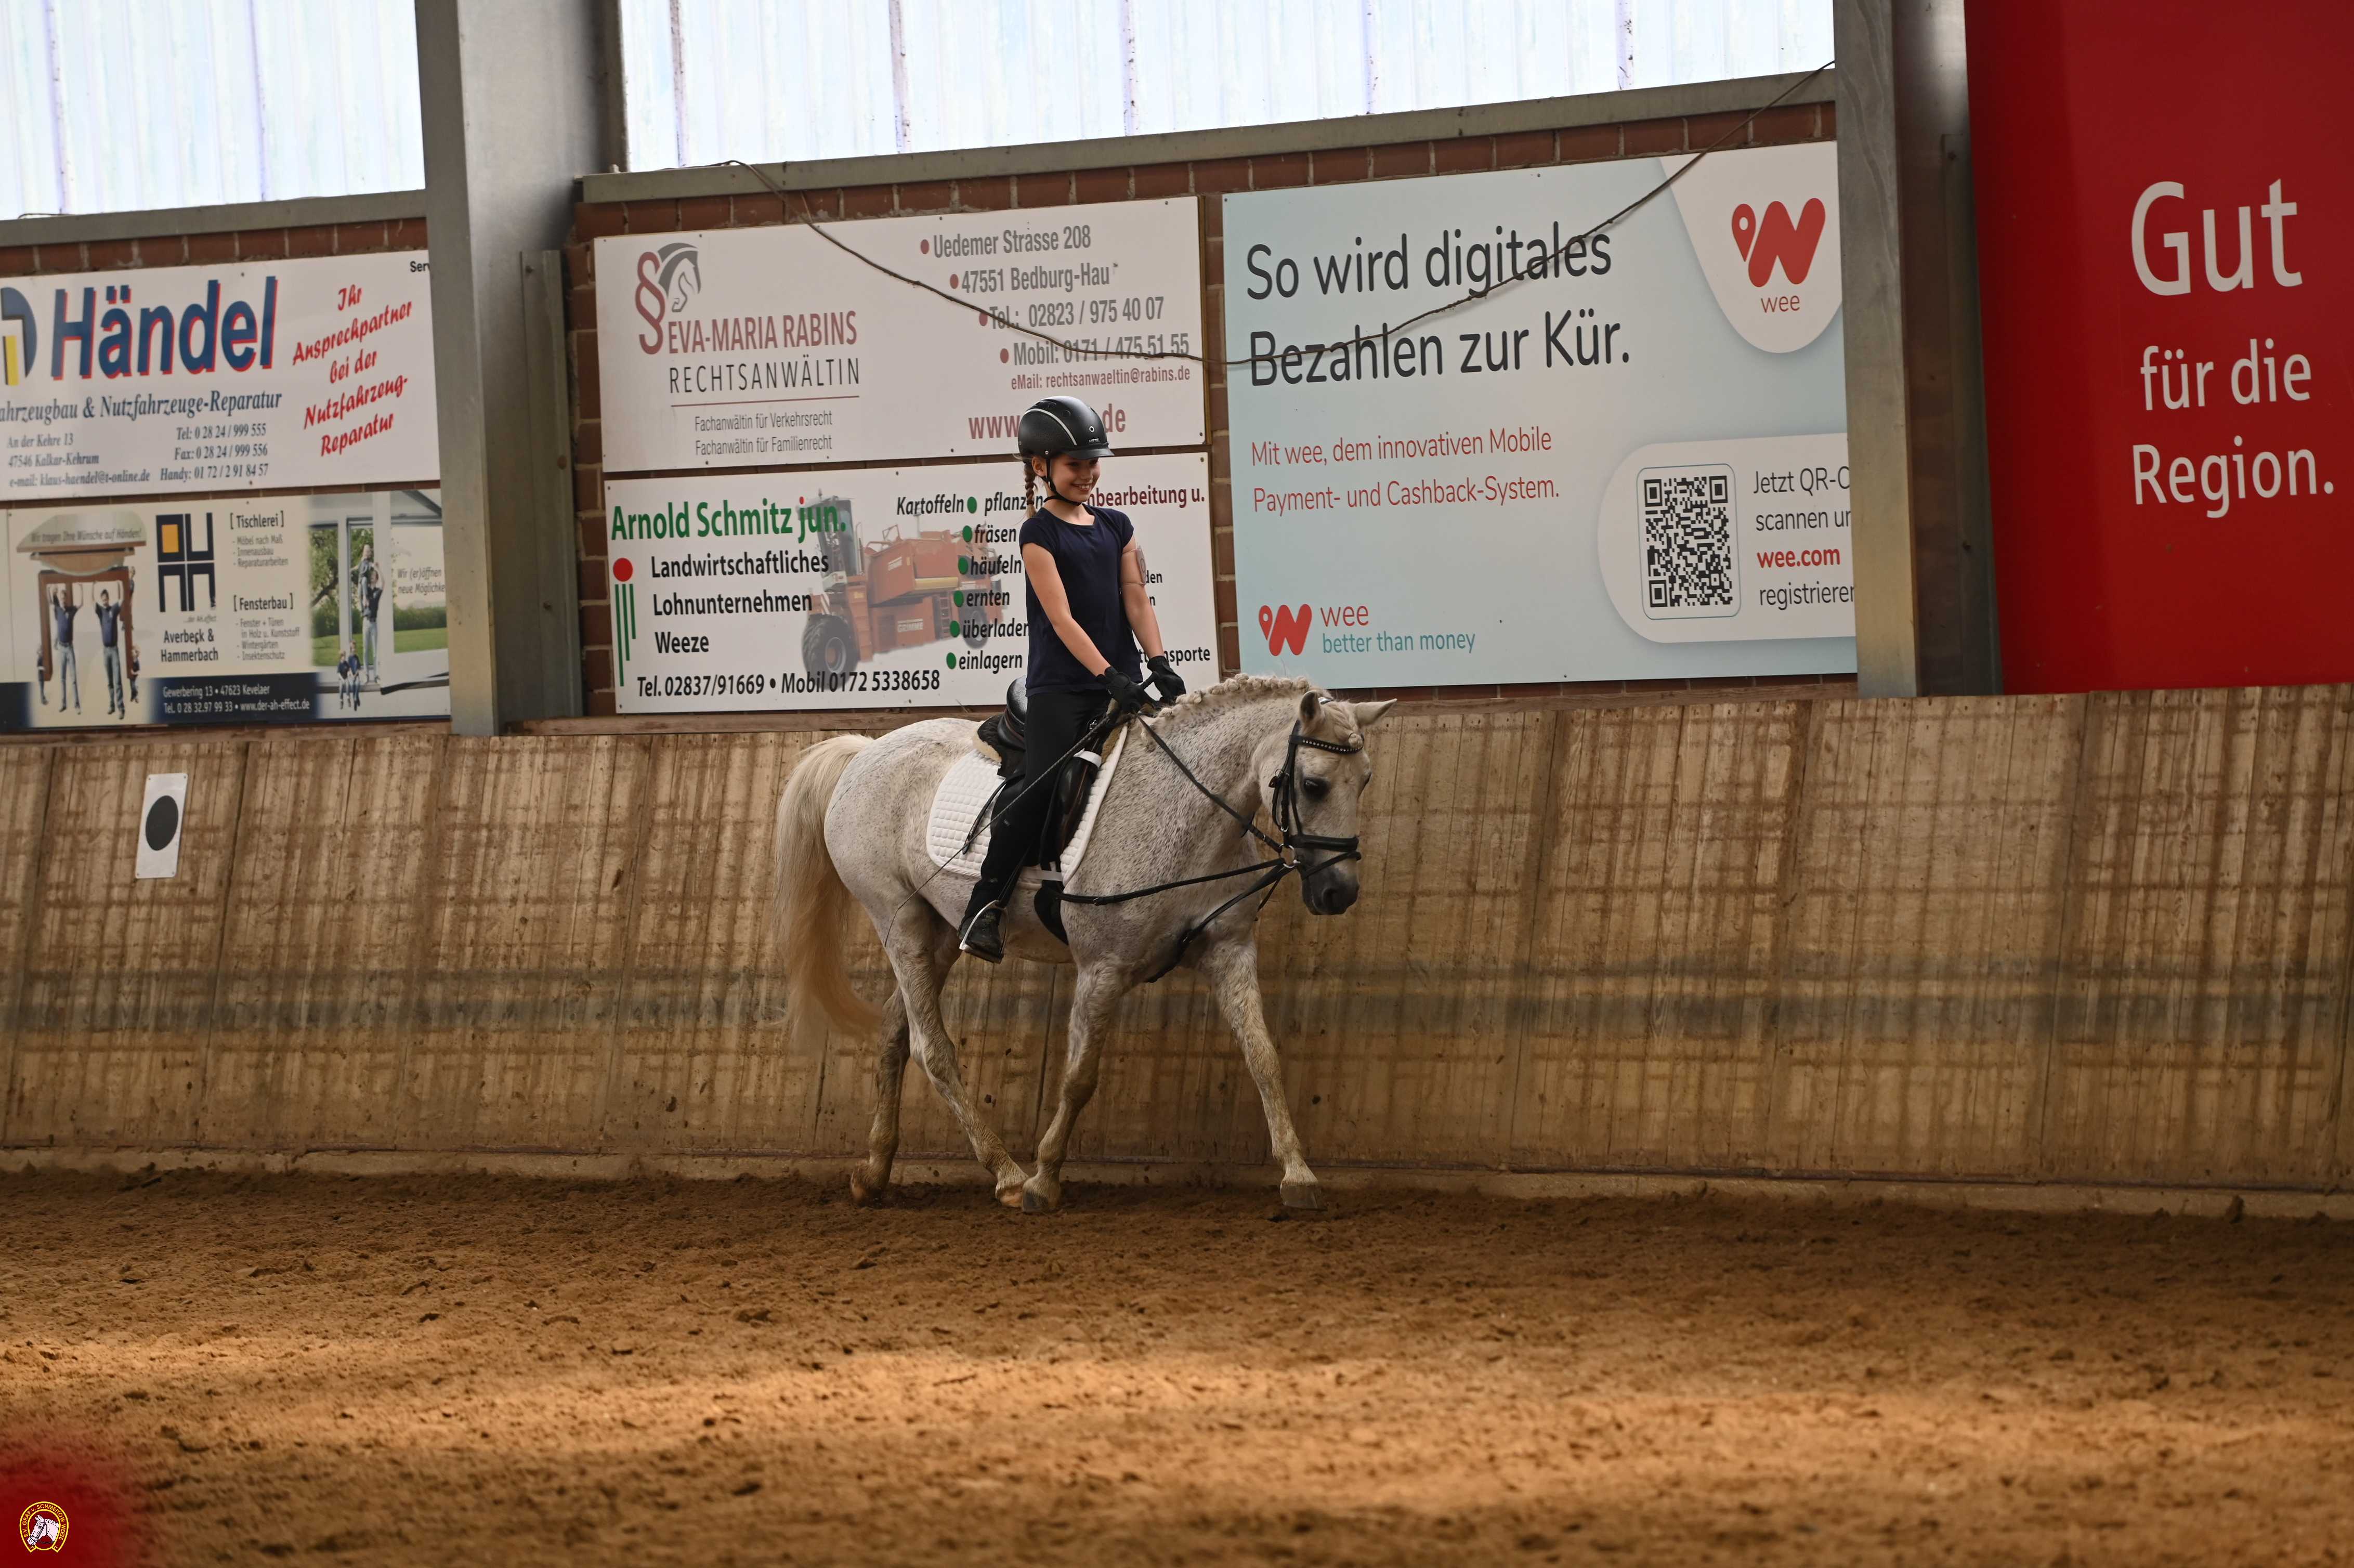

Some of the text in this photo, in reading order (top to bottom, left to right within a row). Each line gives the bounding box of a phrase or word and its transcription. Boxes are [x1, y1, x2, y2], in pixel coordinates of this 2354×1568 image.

[933, 225, 1091, 258] Uedemer Strasse 208
[2131, 178, 2303, 296] Gut
[1247, 220, 1612, 300] So wird digitales
[961, 262, 1109, 294] 47551 Bedburg-Hau
[338, 284, 362, 311] Ihr
[1761, 295, 1800, 313] wee
[1029, 302, 1074, 327] 02823
[1090, 299, 1117, 323] 975
[1122, 297, 1141, 321] 40
[1146, 296, 1164, 320] 07
[50, 275, 278, 380] Händel
[292, 301, 412, 365] Ansprechpartner
[668, 310, 857, 354] EVA-MARIA RABINS
[1014, 333, 1189, 365] Mobil: 0171 475 51 55
[1250, 308, 1630, 386] Bezahlen zur Kür.
[330, 349, 377, 384] bei der
[670, 354, 859, 394] RECHTSANWÄLTIN
[1011, 365, 1190, 390] eMail: rechtsanwaeltin@rabins.de
[2140, 337, 2312, 411] für die
[83, 396, 95, 418] &
[100, 389, 282, 421] Nutzfahrzeuge-Reparatur
[304, 375, 408, 429] Nutzfahrzeug-
[177, 426, 192, 440] Tel:
[203, 426, 213, 439] 28
[215, 425, 226, 438] 24
[234, 424, 249, 437] 999
[251, 423, 266, 436] 555
[695, 410, 832, 432] Fachanwältin für Verkehrsrecht
[21, 435, 34, 447] der
[37, 434, 61, 447] Kehre
[64, 433, 73, 446] 13
[321, 413, 394, 457] Reparatur
[695, 435, 832, 455] Fachanwältin für Familienrecht
[1252, 425, 1551, 466] Mit wee, dem innovativen Mobile
[35, 452, 99, 467] Kalkar-Kehrum
[175, 447, 194, 460] Fax:
[204, 446, 214, 459] 28
[217, 445, 227, 458] 24
[235, 444, 250, 457] 999
[252, 443, 268, 456] 556
[10, 469, 150, 487] e-mail: klaus-haendel@t-online.de
[160, 467, 191, 483] Handy:
[207, 465, 217, 478] 72
[233, 464, 243, 477] 91
[258, 463, 268, 476] 57
[1754, 471, 1795, 494] Jetzt
[2132, 435, 2334, 519] Region.
[896, 491, 1043, 517] Kartoffeln pflanzn
[1088, 485, 1205, 508] nbearbeitung u.
[1253, 475, 1559, 517] Payment- und Cashback-System.
[236, 513, 278, 528] Tischlerei
[611, 496, 846, 543] Arnold Schmitz jun.
[1756, 511, 1828, 531] scannen
[974, 524, 1017, 544] fräsen
[651, 549, 829, 578] Landwirtschaftliches
[971, 555, 1022, 575] häufeln
[1757, 548, 1840, 568] wee.com
[240, 595, 287, 610] Fensterbau
[653, 589, 813, 616] Lohnunternehmen
[966, 590, 1010, 607] ernten
[1320, 605, 1369, 627] wee
[164, 628, 214, 643] Averbeck &
[655, 631, 710, 654] Weeze
[1323, 630, 1476, 654] better than money
[161, 647, 218, 662] Hammerbach
[959, 650, 1023, 674] einlagern
[163, 684, 270, 699] Gewerbering 13 47623 Kevelaer
[637, 669, 940, 697] Tel. 02837/91669 Mobil 0172 5338658
